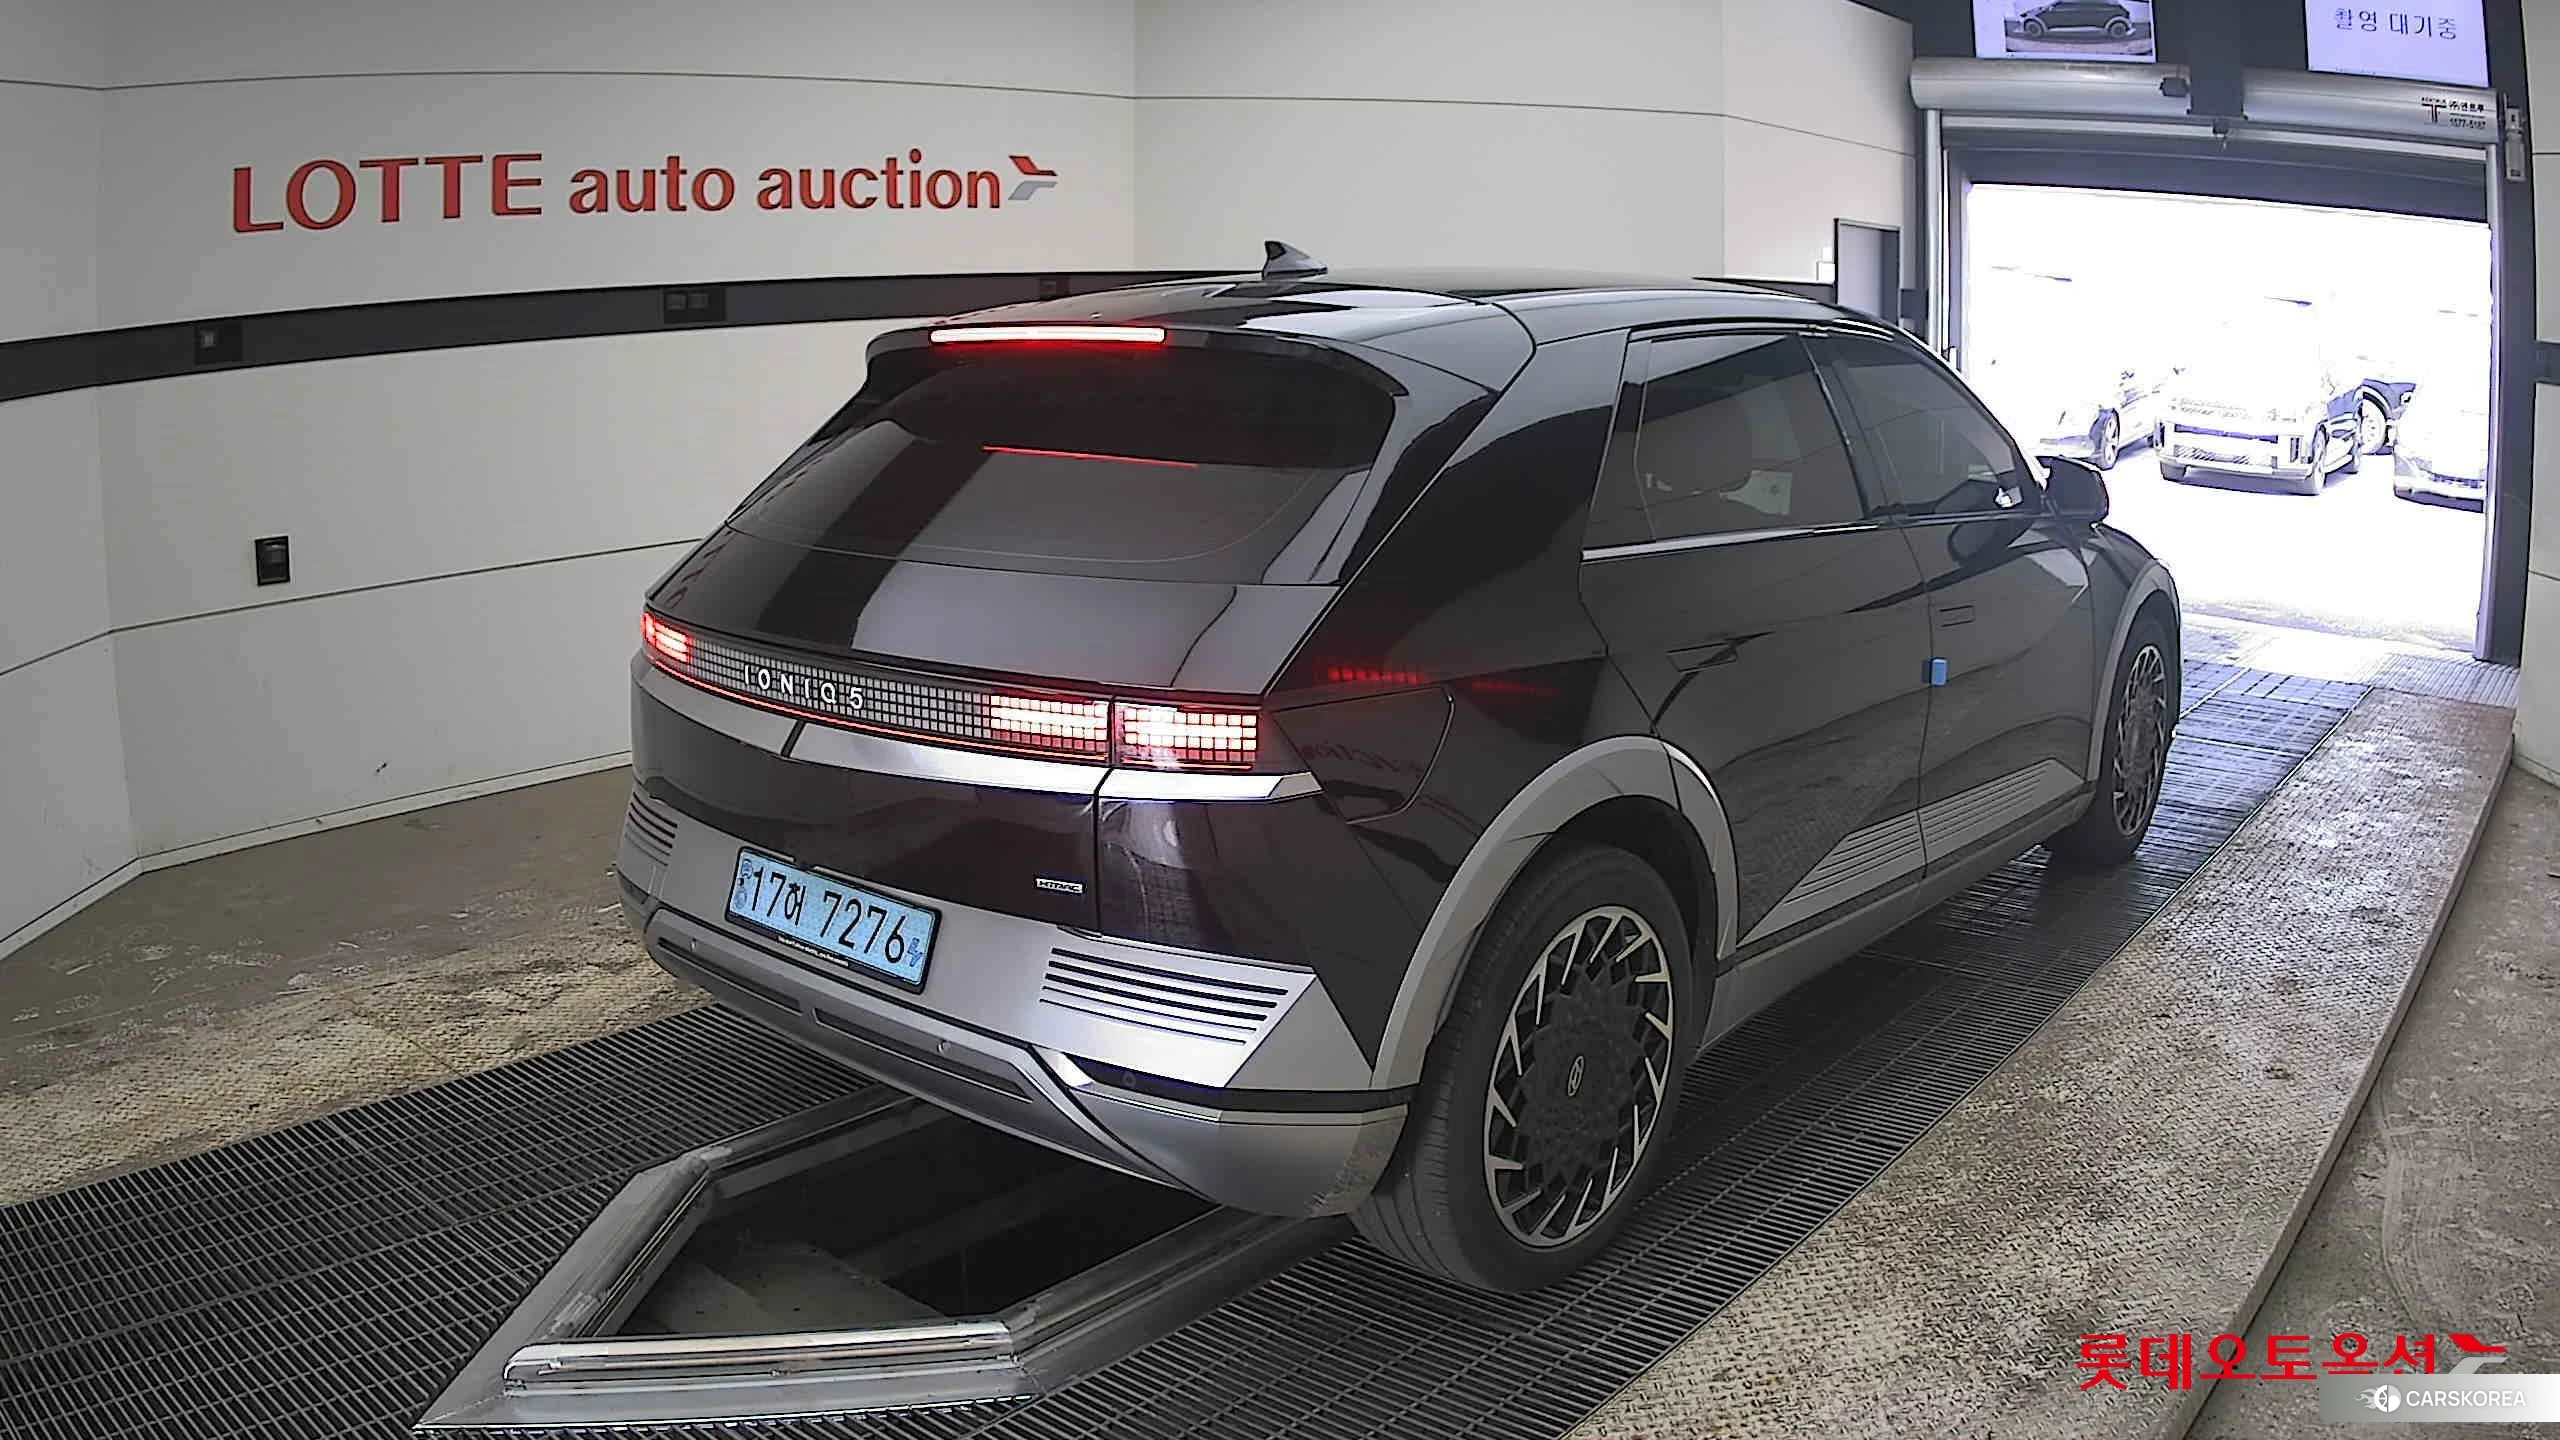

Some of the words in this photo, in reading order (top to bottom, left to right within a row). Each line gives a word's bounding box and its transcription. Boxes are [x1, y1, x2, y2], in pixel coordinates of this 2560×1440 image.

[2389, 9, 2457, 40] 대기중
[233, 153, 542, 233] LOTTE
[569, 155, 735, 214] auto
[757, 148, 1000, 210] auction
[744, 664, 837, 705] IONIQ
[849, 686, 864, 710] 5
[752, 866, 807, 926] 17허
[820, 889, 907, 964] 7276
